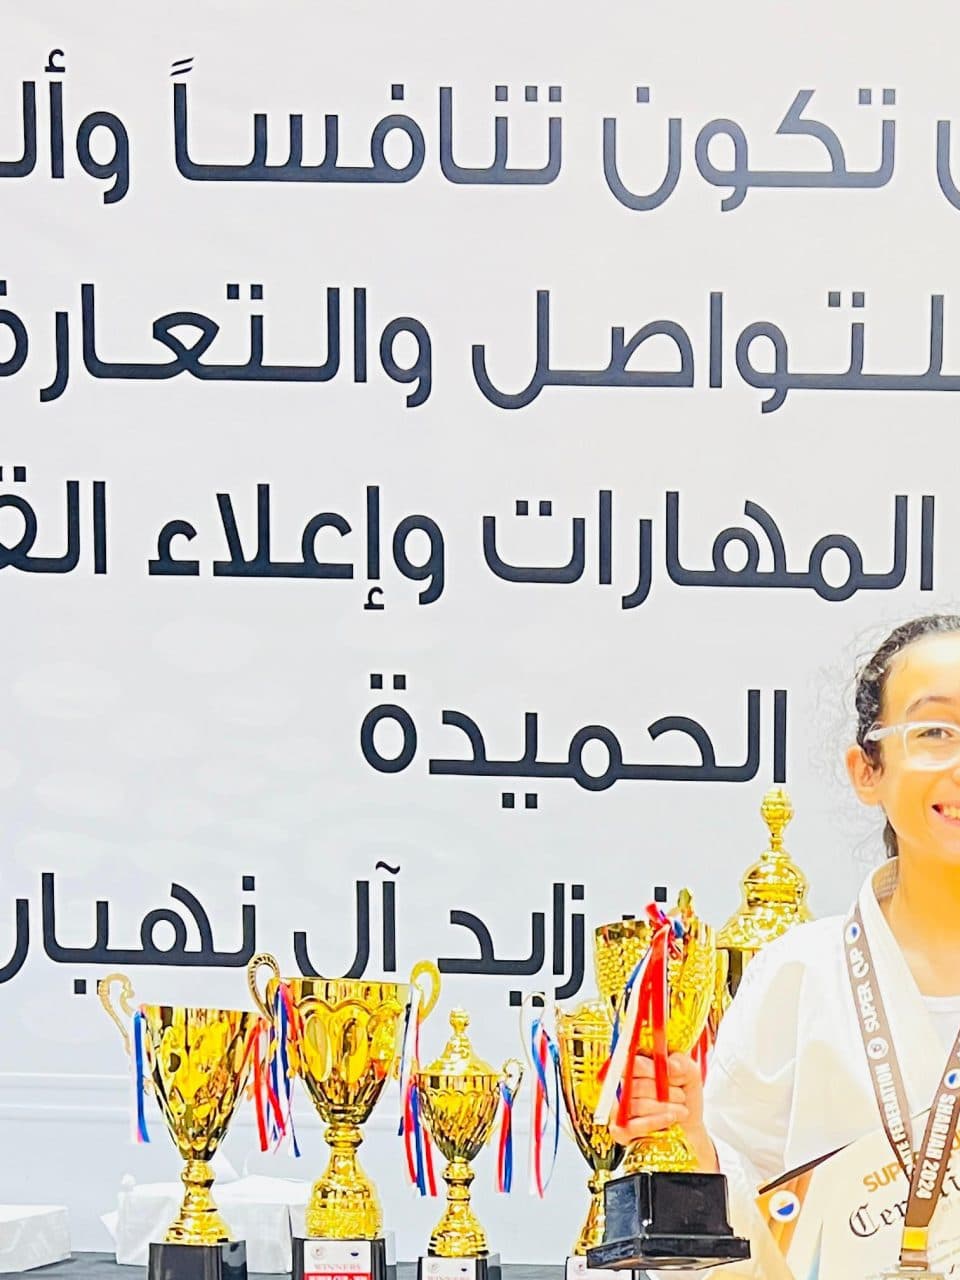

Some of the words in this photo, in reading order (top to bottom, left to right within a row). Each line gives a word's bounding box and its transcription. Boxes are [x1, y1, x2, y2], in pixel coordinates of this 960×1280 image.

[170, 56, 563, 186] تنافساً
[602, 86, 896, 215] تكون
[147, 483, 445, 611] وإعلاء
[482, 490, 936, 611] المهارات
[359, 673, 788, 810] الحميدة
[293, 860, 401, 982] آل
[436, 882, 586, 1008] زايد
[849, 947, 870, 979] CUP
[856, 981, 881, 1033] SUPER
[915, 1159, 940, 1200] 2024
